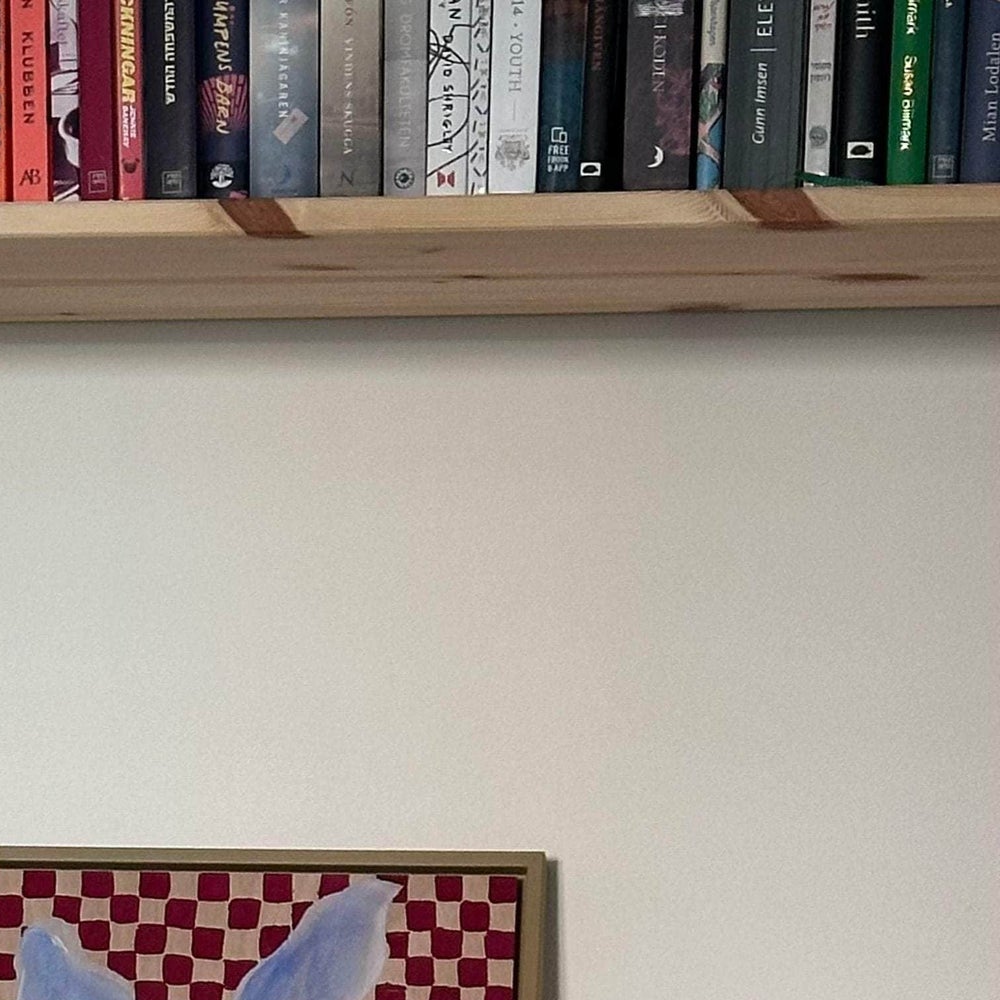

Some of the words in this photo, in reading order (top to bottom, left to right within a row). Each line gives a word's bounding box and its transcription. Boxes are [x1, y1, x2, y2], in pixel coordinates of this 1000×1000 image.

[756, 0, 774, 37] ELE
[22, 32, 35, 125] KLUBBEN
[509, 33, 524, 92] YOUTH
[754, 62, 768, 104] Imsen
[903, 55, 918, 96] Susan
[984, 32, 1000, 96] Lodalen
[164, 65, 177, 105] החדש
[343, 103, 354, 155] SKUGGA
[441, 85, 454, 153] SHRIGLEY
[751, 107, 767, 145] Gunn
[981, 100, 998, 142] Mian
[548, 145, 570, 155] FREE
